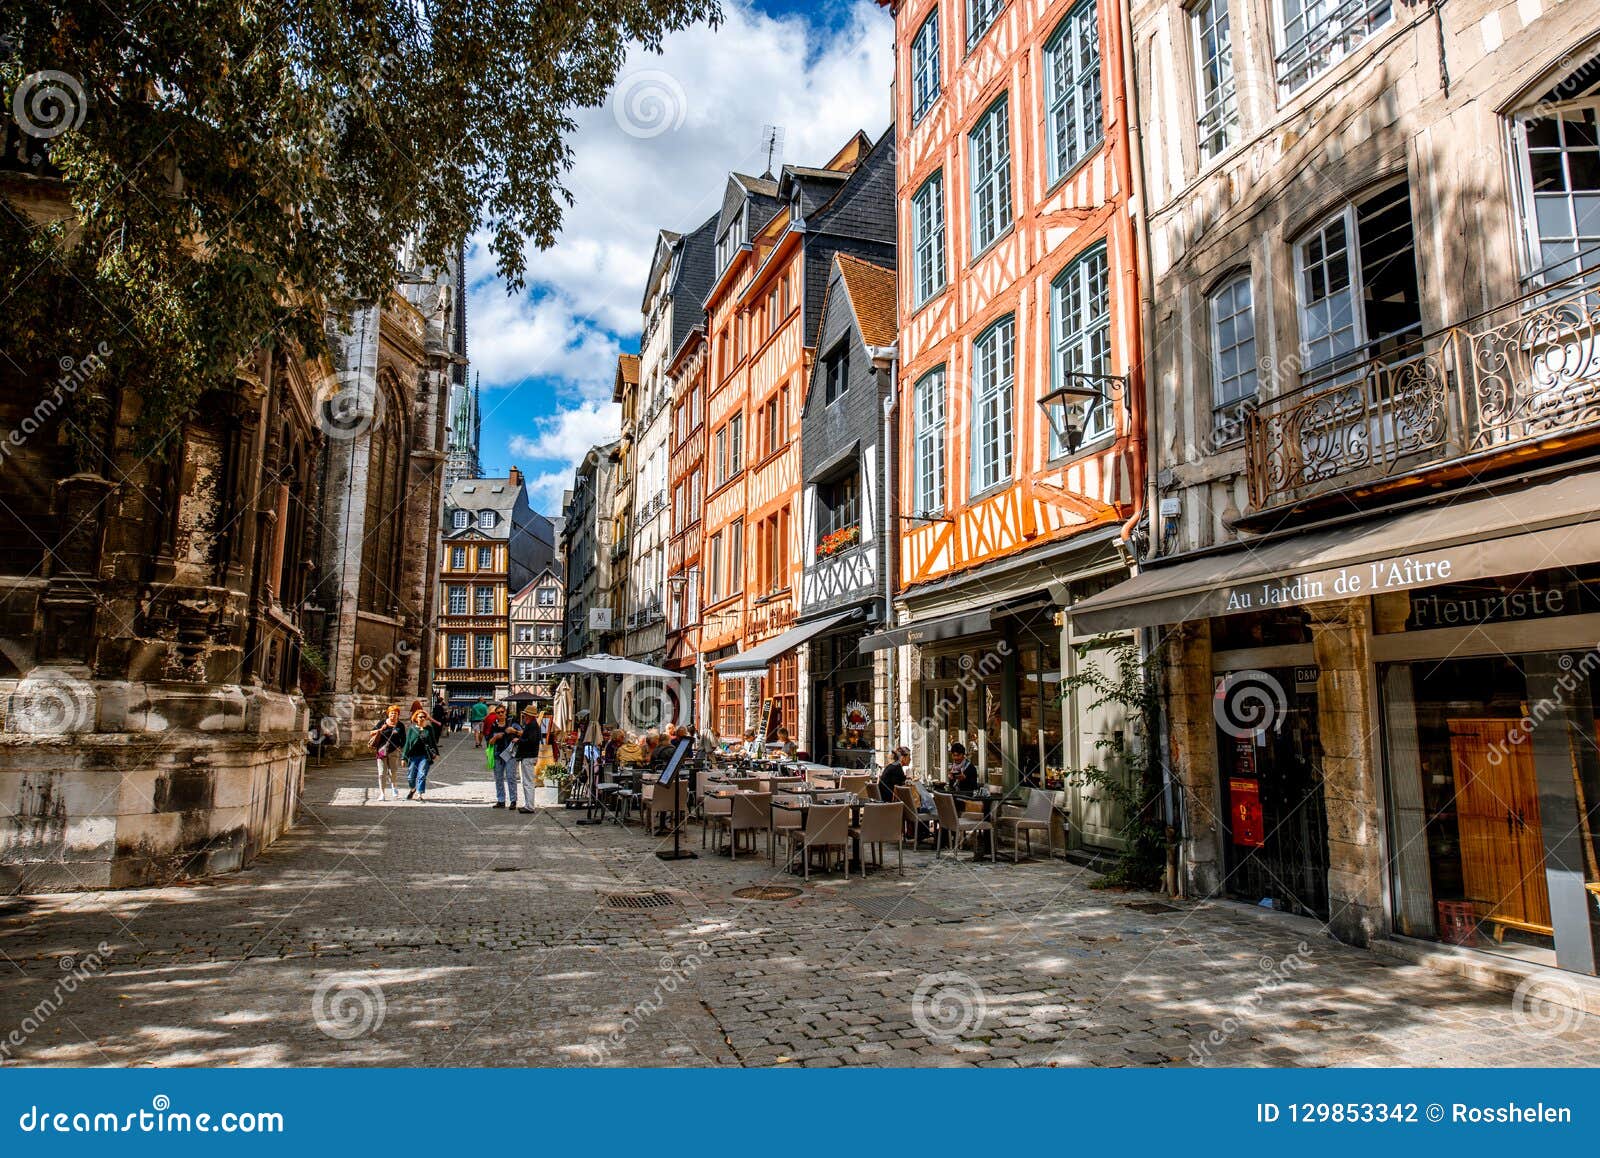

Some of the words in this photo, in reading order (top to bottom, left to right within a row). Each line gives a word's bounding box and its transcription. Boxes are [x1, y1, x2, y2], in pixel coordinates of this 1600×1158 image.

[1226, 590, 1251, 611] Au
[1259, 577, 1323, 606] Jardin
[1333, 570, 1361, 594] de
[1371, 557, 1451, 589] l'Aître
[1411, 585, 1564, 626] Fleuriste
